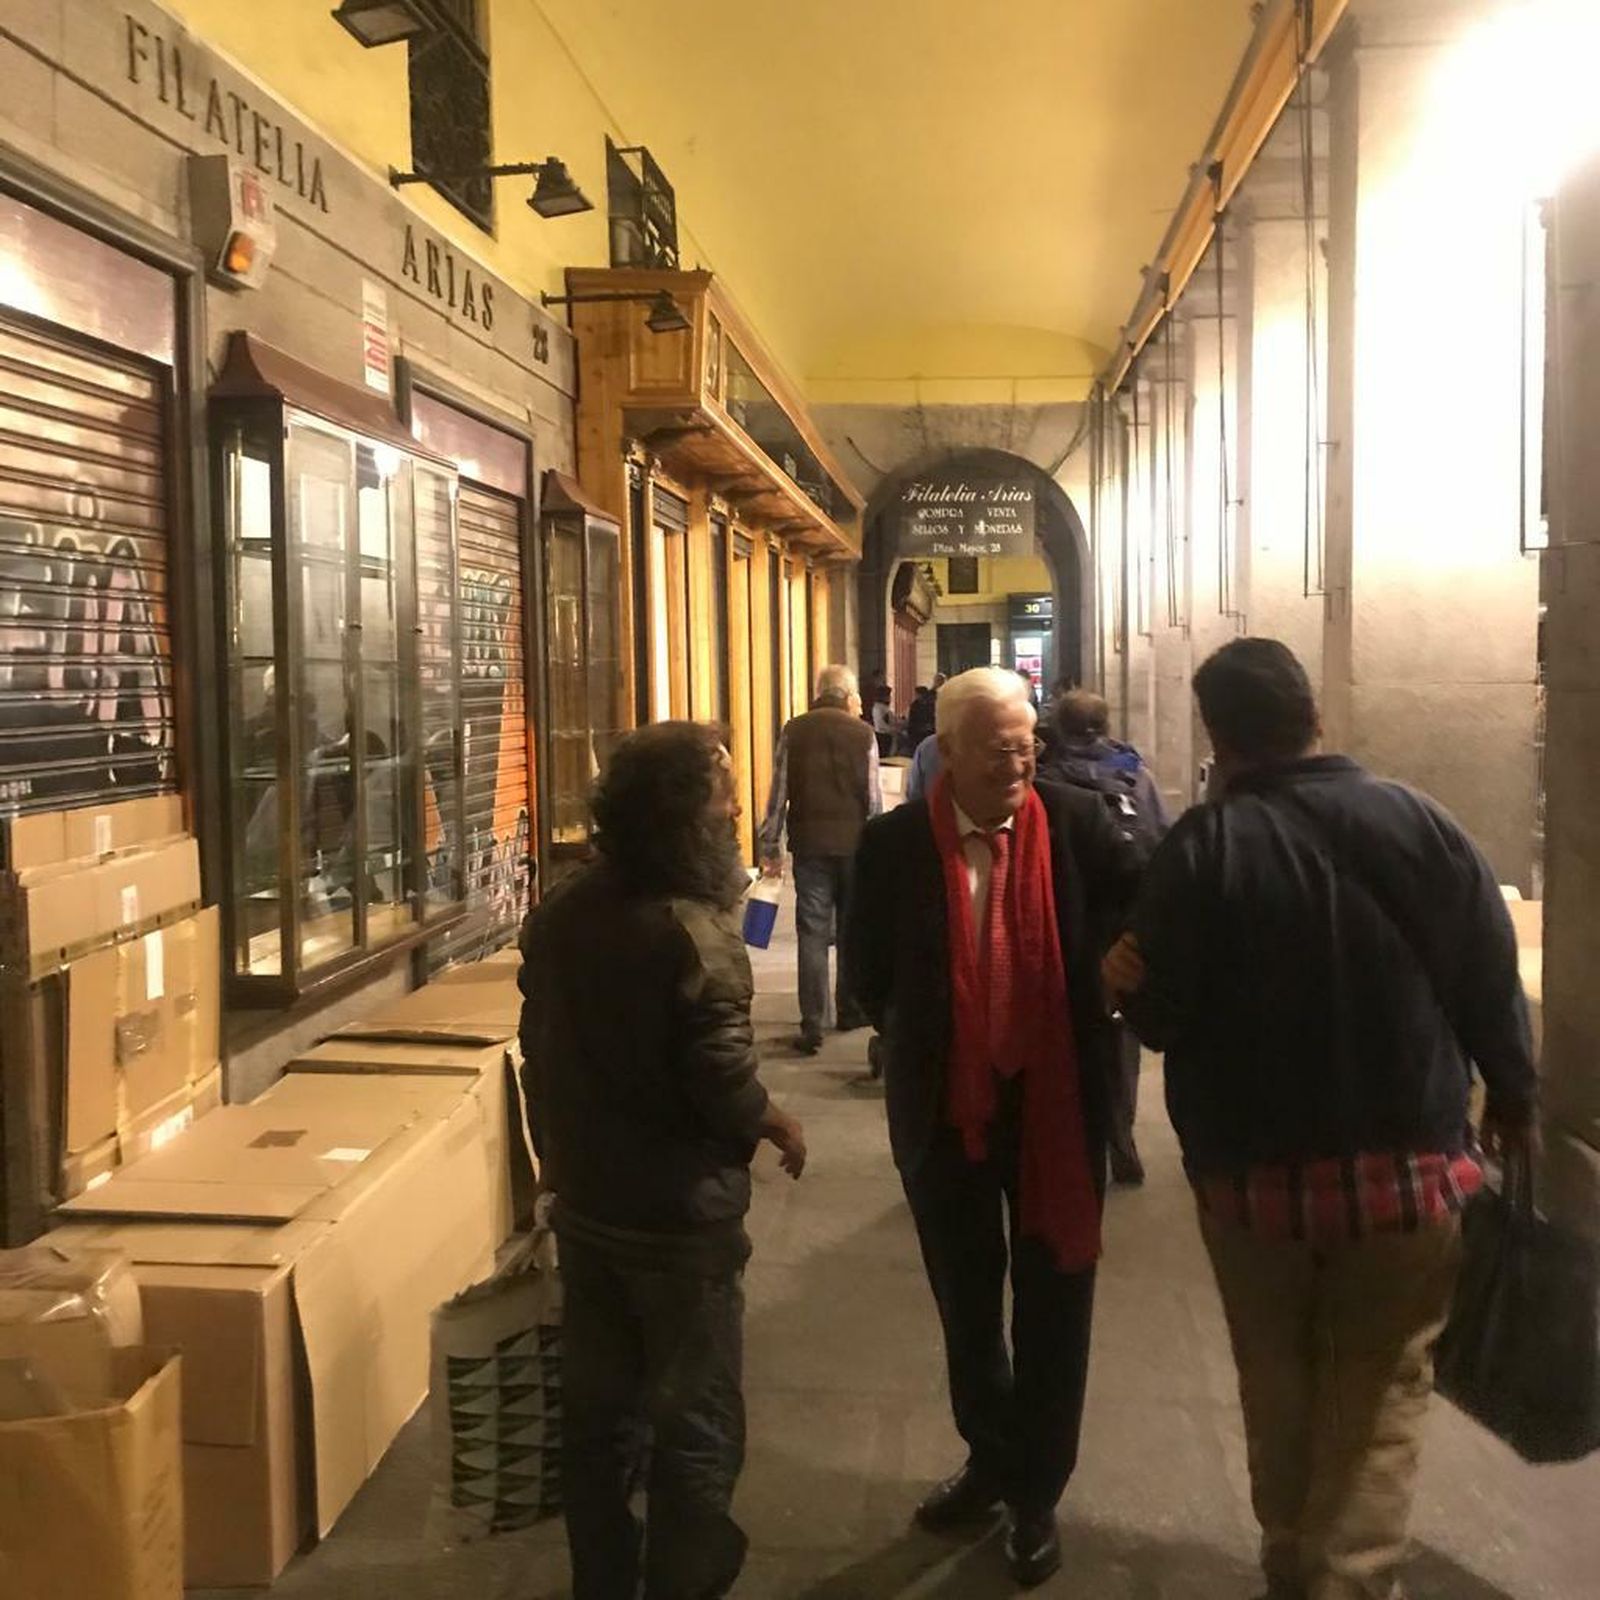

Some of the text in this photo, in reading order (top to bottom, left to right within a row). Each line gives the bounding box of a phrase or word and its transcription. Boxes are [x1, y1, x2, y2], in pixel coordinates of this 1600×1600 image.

[126, 14, 329, 214] FILATELIA
[401, 224, 494, 332] ARIAS
[902, 483, 1032, 502] Filatelia Arias
[987, 507, 1017, 518] VENTA
[912, 524, 949, 535] SELLOS
[958, 524, 965, 535] Y
[1024, 603, 1041, 614] 30
